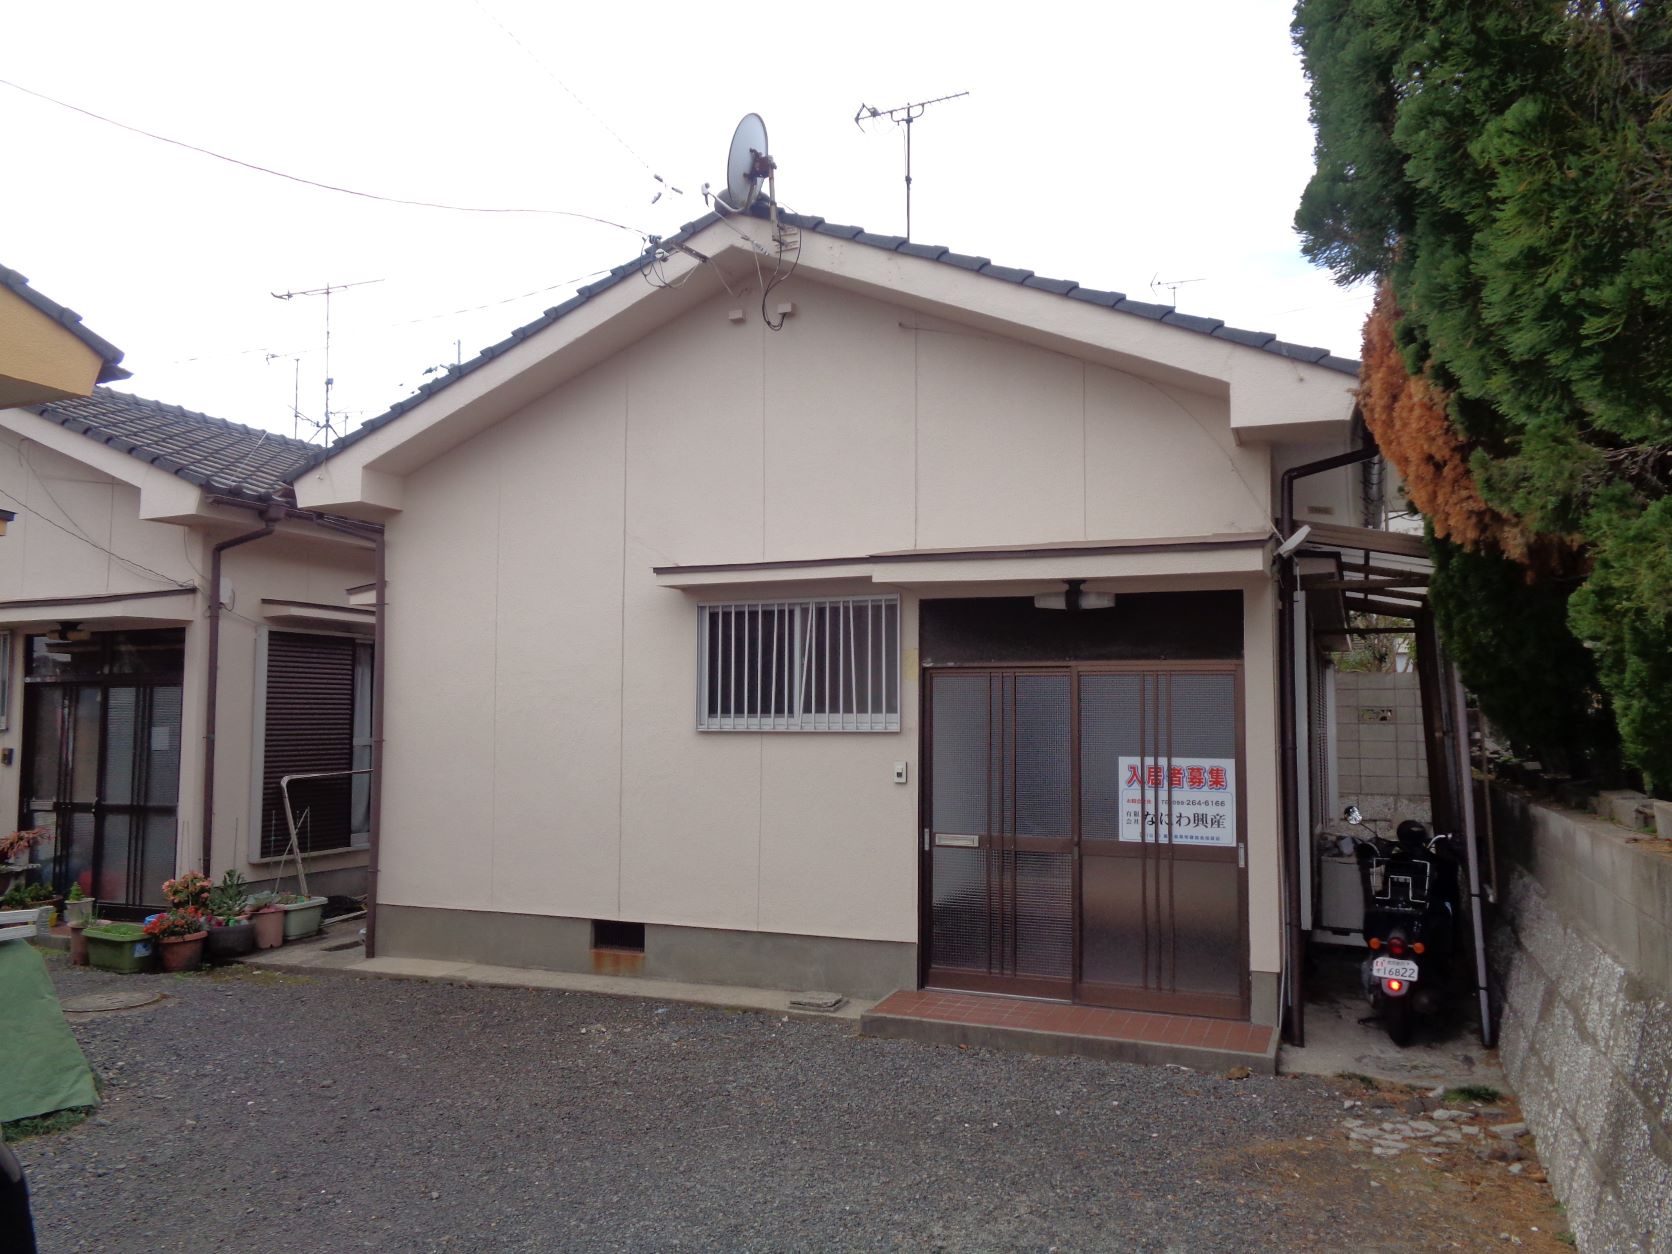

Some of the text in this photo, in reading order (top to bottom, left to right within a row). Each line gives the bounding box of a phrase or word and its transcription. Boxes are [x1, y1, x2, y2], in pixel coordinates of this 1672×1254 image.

[1126, 764, 1228, 790] 入居者募集
[1144, 812, 1227, 829] なにわ興産
[1383, 967, 1416, 978] 16822
